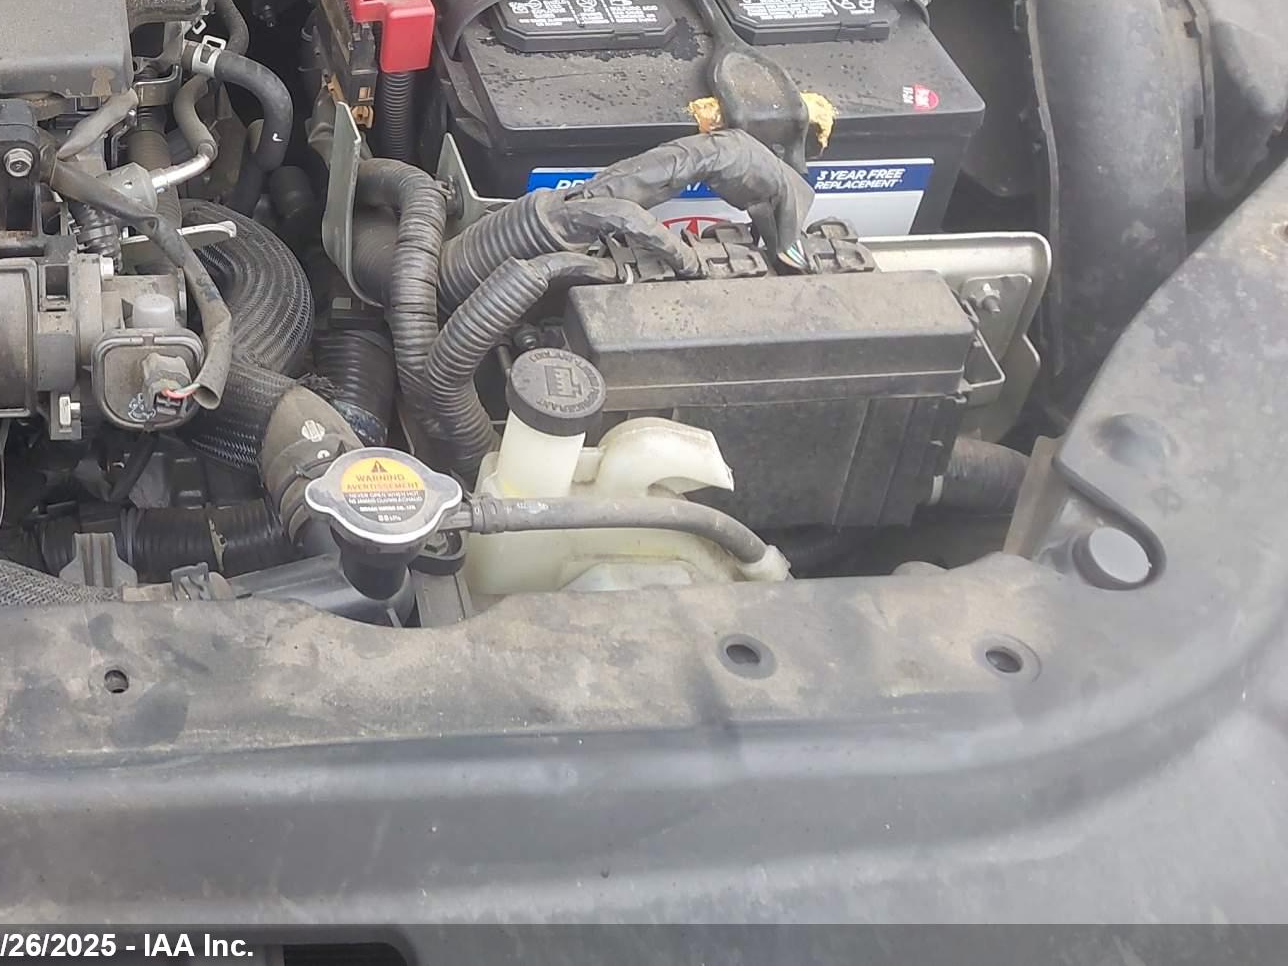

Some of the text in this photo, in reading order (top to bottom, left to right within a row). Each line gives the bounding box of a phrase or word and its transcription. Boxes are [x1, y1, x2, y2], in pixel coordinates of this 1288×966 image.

[816, 168, 906, 181] 3 YEAR FREE
[355, 473, 406, 482] WARNING
